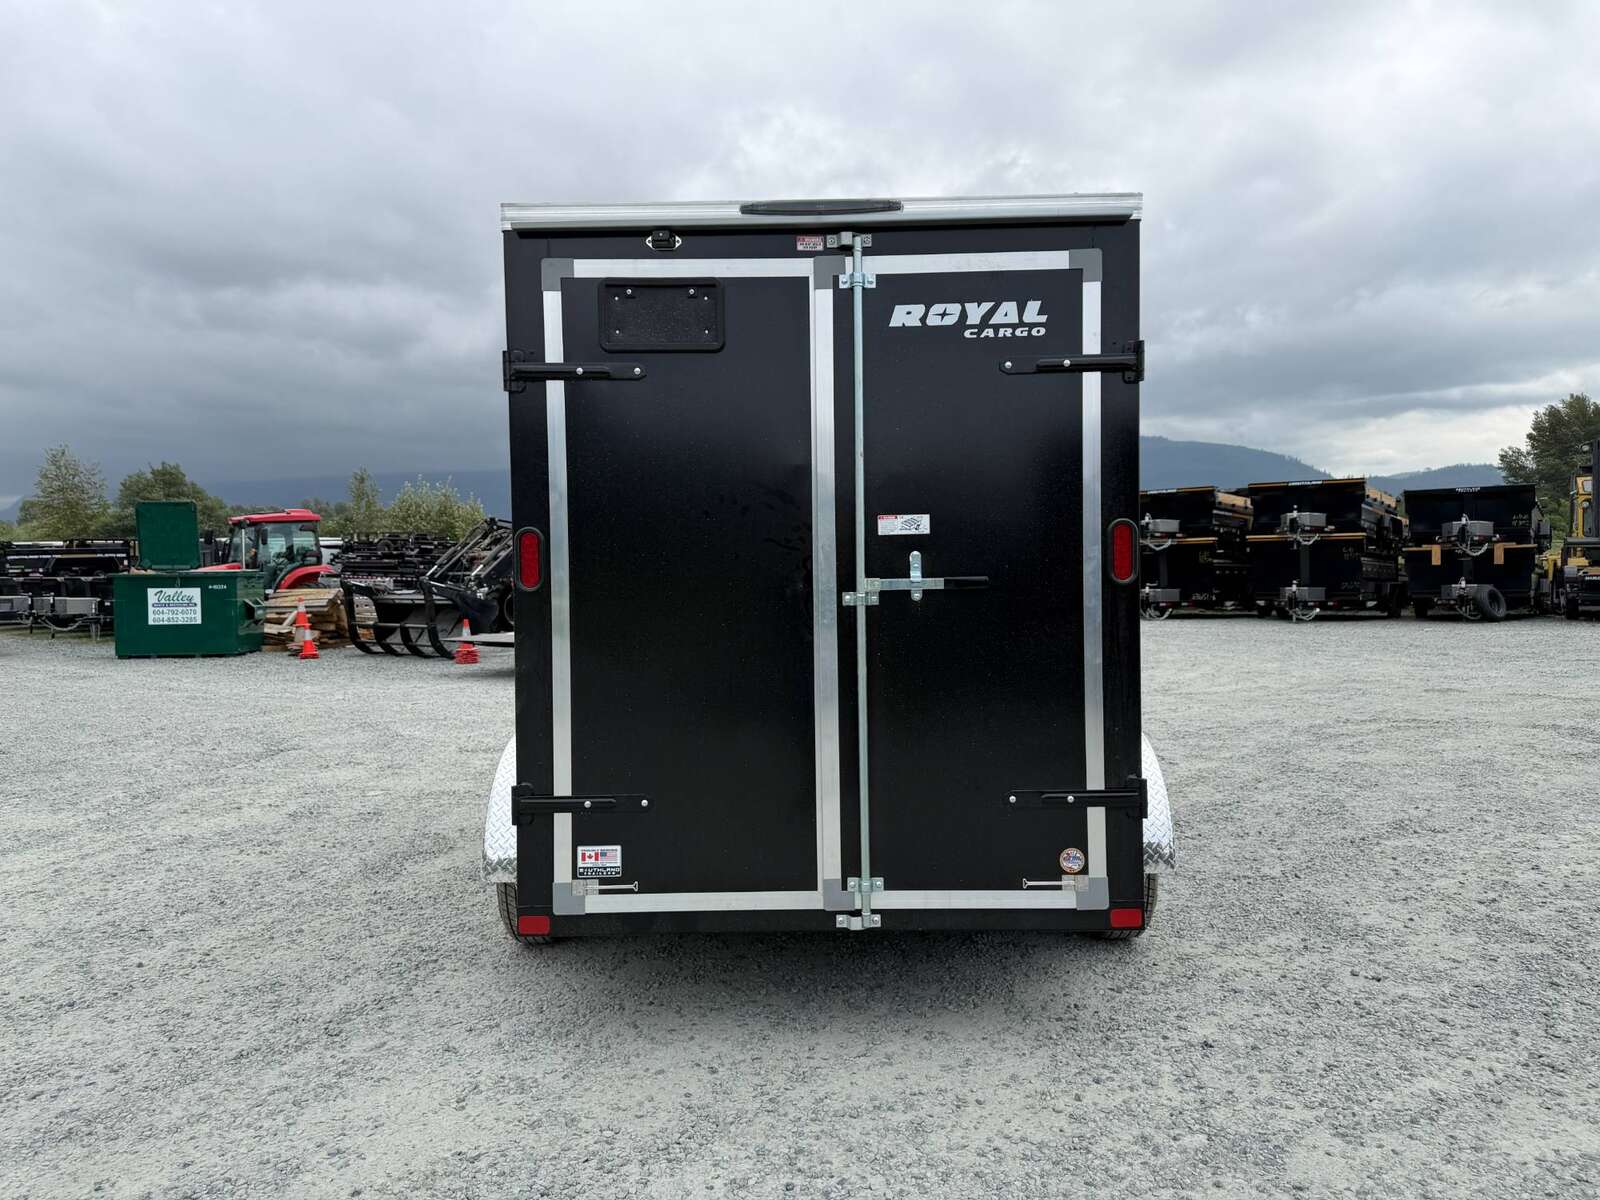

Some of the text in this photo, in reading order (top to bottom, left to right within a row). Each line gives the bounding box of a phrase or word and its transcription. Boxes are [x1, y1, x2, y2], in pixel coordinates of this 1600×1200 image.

[888, 300, 1048, 327] ROYAL
[963, 326, 1046, 339] CARGO
[154, 589, 194, 603] Valley
